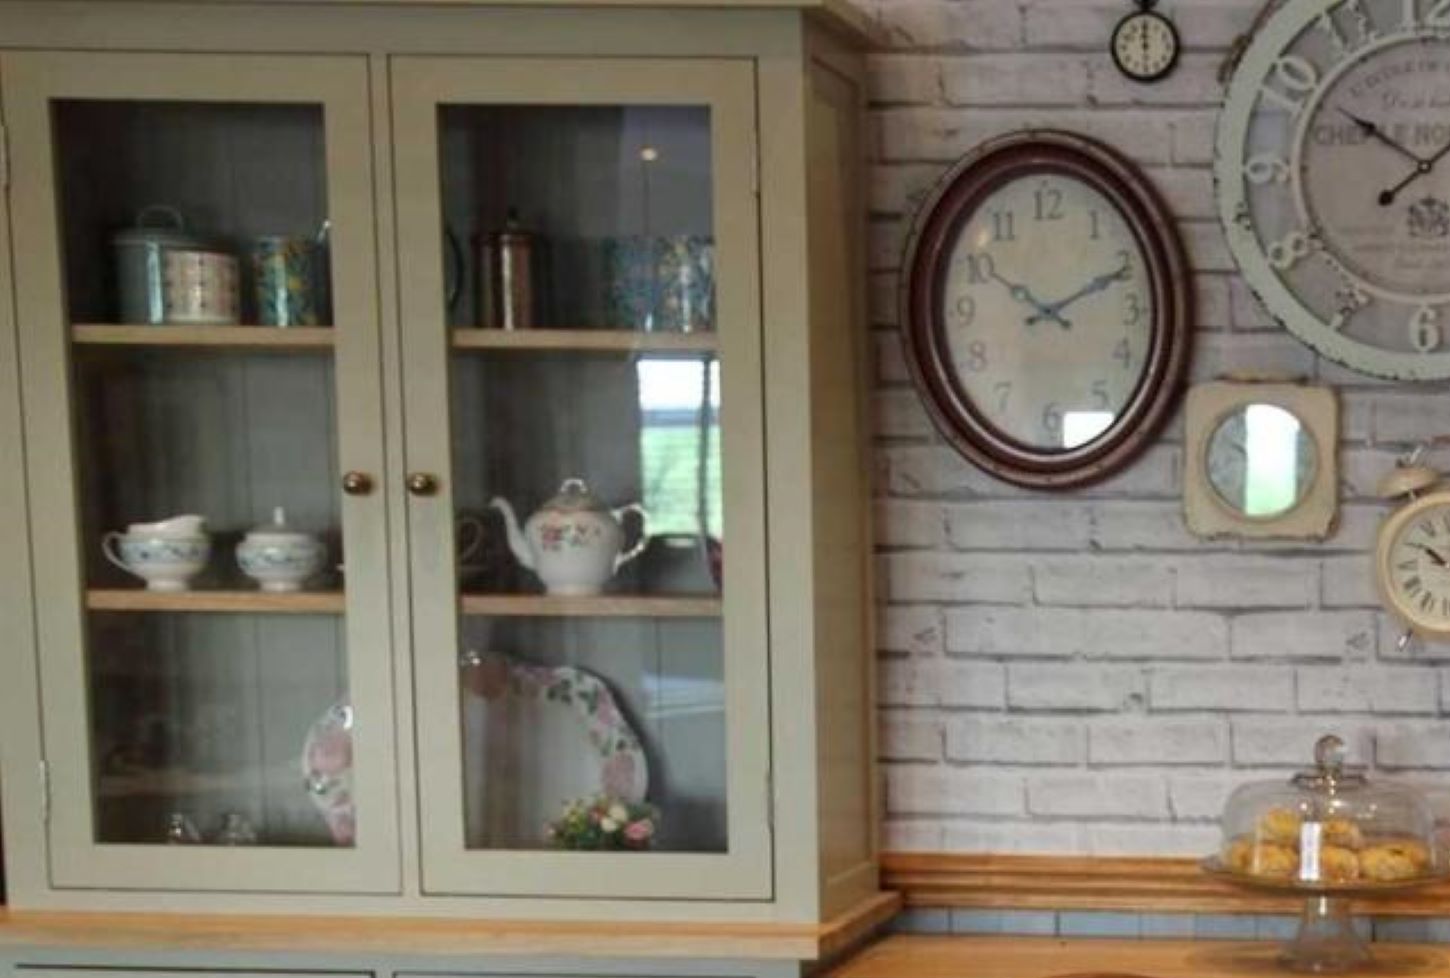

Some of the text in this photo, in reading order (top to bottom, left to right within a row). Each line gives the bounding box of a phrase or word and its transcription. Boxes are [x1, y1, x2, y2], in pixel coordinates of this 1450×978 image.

[1033, 189, 1063, 221] 12
[992, 210, 1016, 242] 11
[1089, 211, 1101, 240] 1
[966, 254, 995, 285] 10
[956, 299, 976, 328] 9
[1123, 294, 1141, 327] 3
[1409, 306, 1440, 354] 6
[968, 341, 988, 372] 8
[1113, 340, 1131, 369] 4
[994, 381, 1013, 412] 7
[1042, 401, 1062, 433] 6
